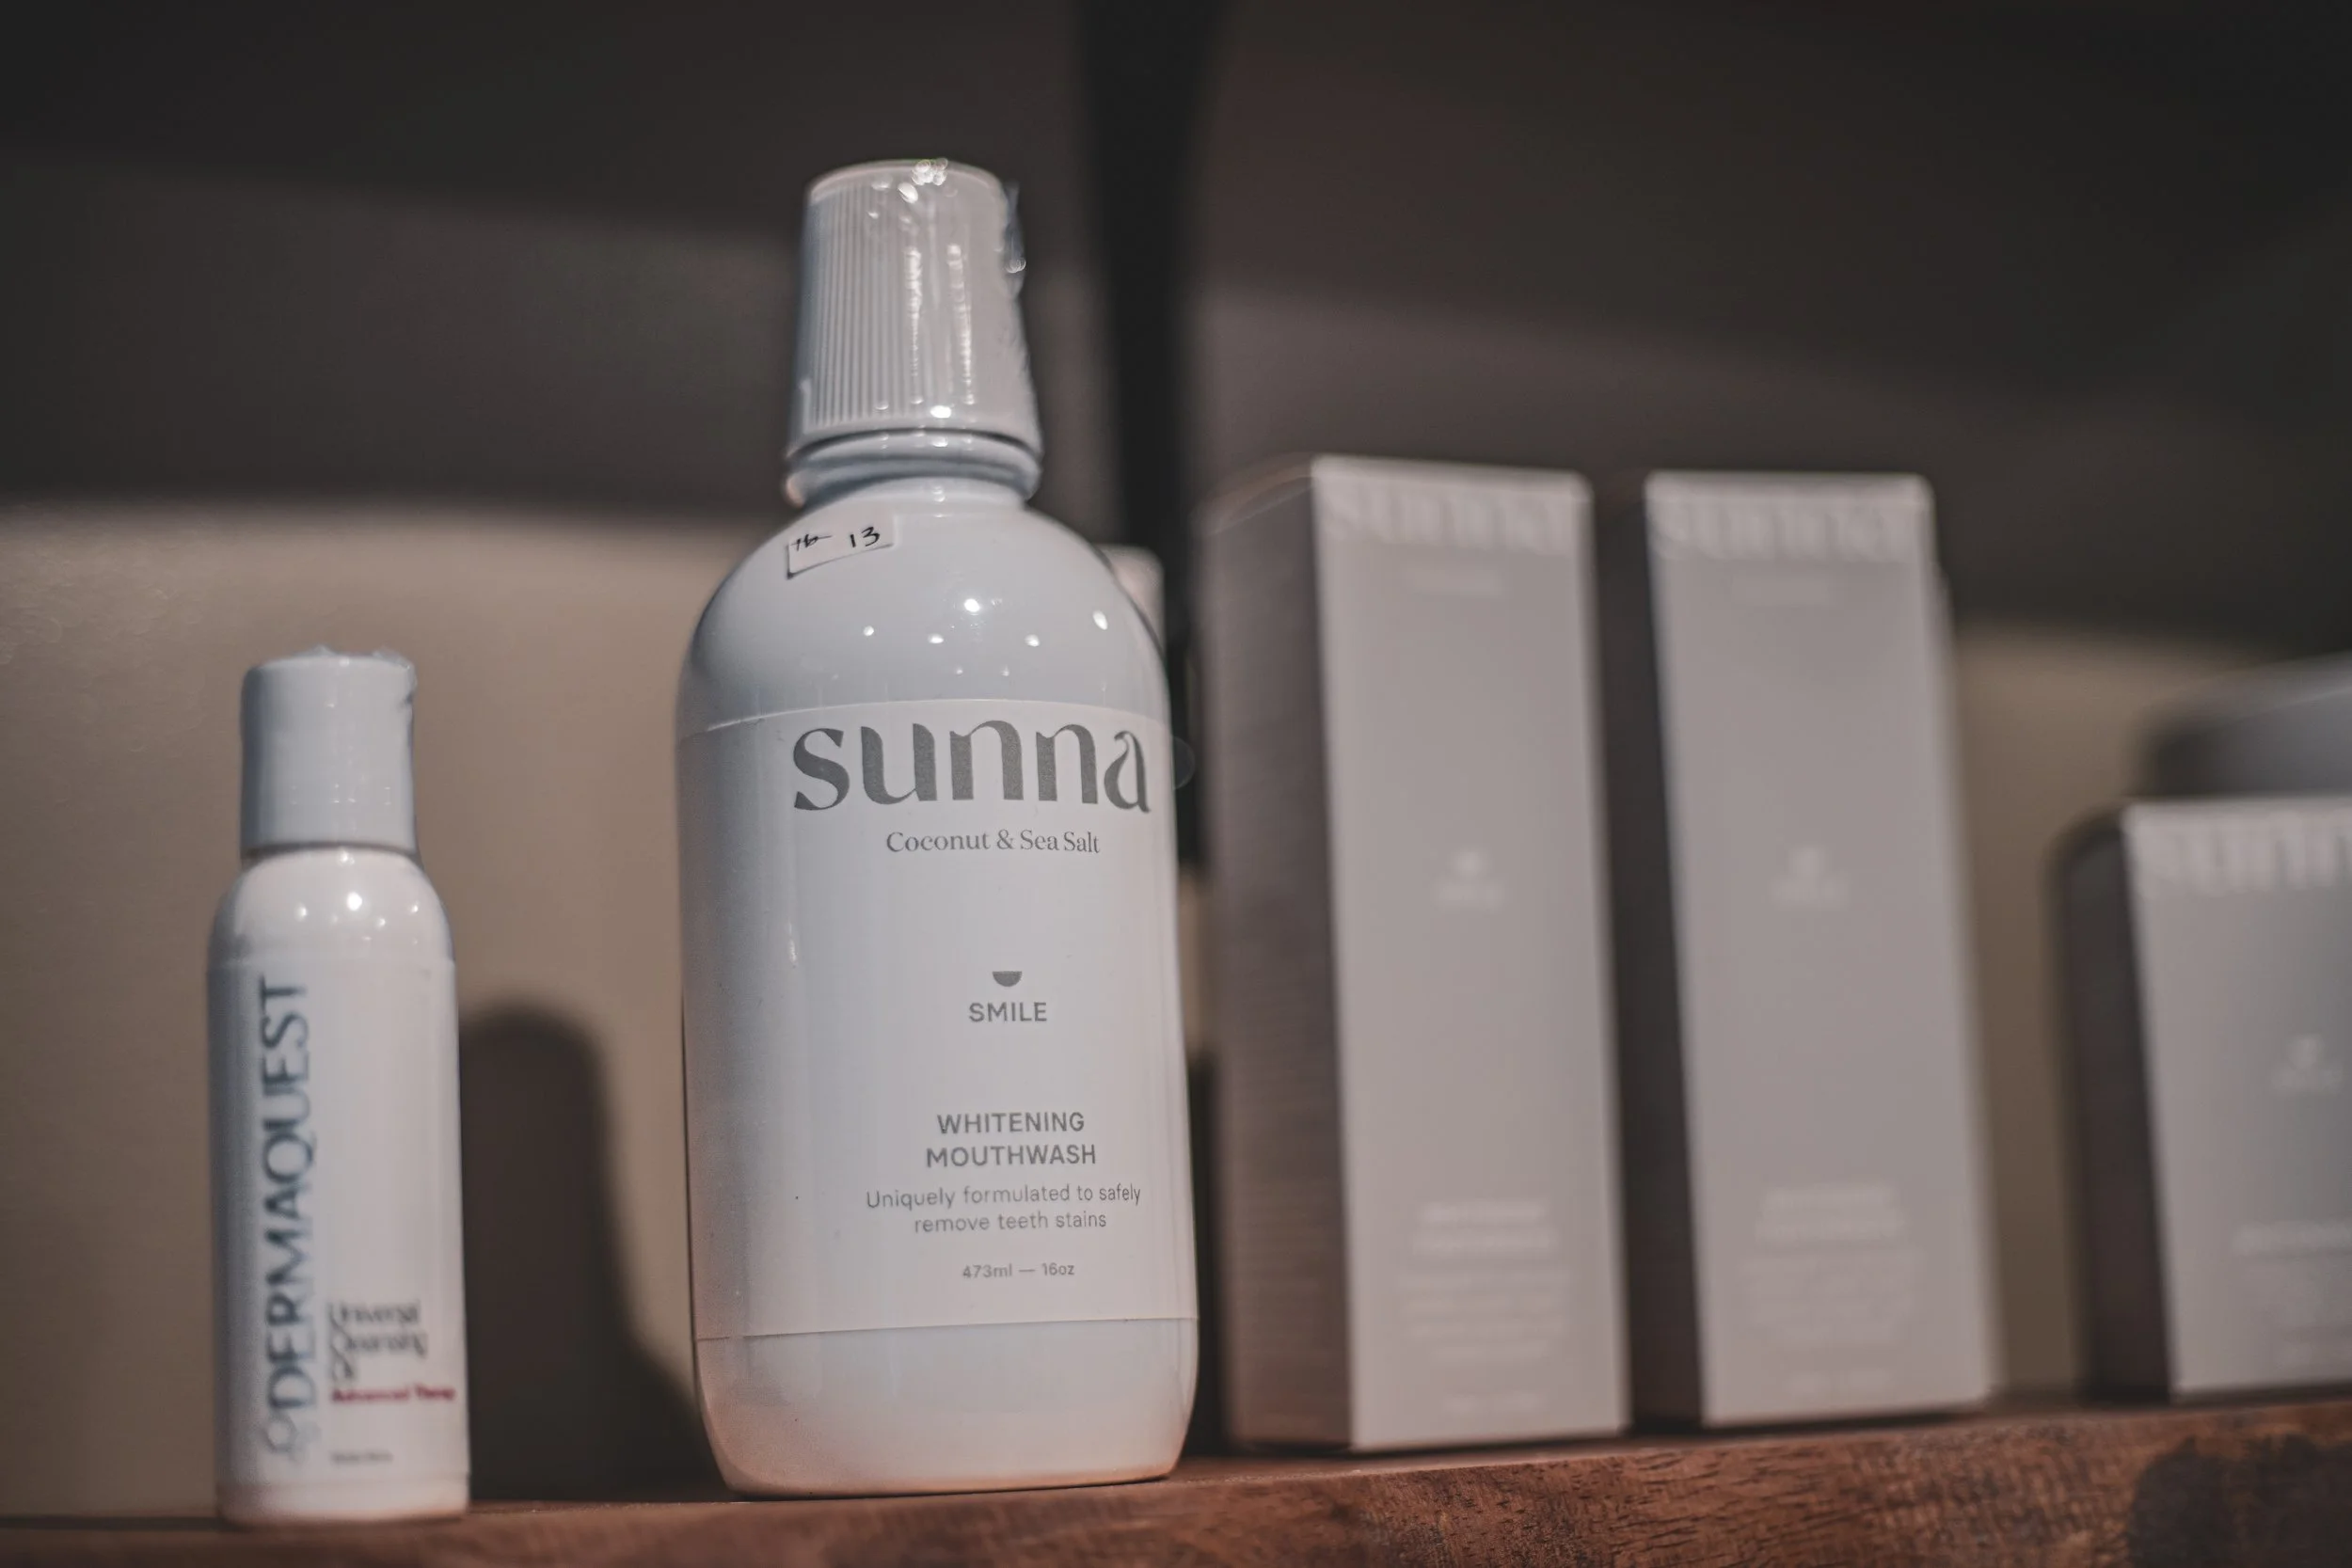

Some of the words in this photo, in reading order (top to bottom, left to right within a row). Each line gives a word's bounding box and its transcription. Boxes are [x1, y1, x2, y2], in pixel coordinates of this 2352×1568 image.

[850, 526, 881, 548] 13
[794, 720, 1151, 813] sunna
[886, 831, 990, 853] Coconut
[995, 830, 1014, 850] &
[1020, 831, 1058, 852] Sea
[1063, 831, 1101, 854] Salt
[968, 1001, 1048, 1022] SMILE
[937, 1112, 1085, 1134] WHITENING
[927, 1144, 1096, 1168] MOUTHWASH
[260, 974, 316, 1411] DERMAQUEST
[866, 1187, 956, 1211] Uniquely
[963, 1184, 1070, 1205] formulated
[1076, 1185, 1093, 1202] to
[1099, 1182, 1141, 1206] safely
[914, 1215, 991, 1233] remove
[998, 1211, 1048, 1230] teeth
[1056, 1211, 1107, 1228] stains
[962, 1263, 1013, 1279] 473ml
[1041, 1263, 1075, 1276] 16oz
